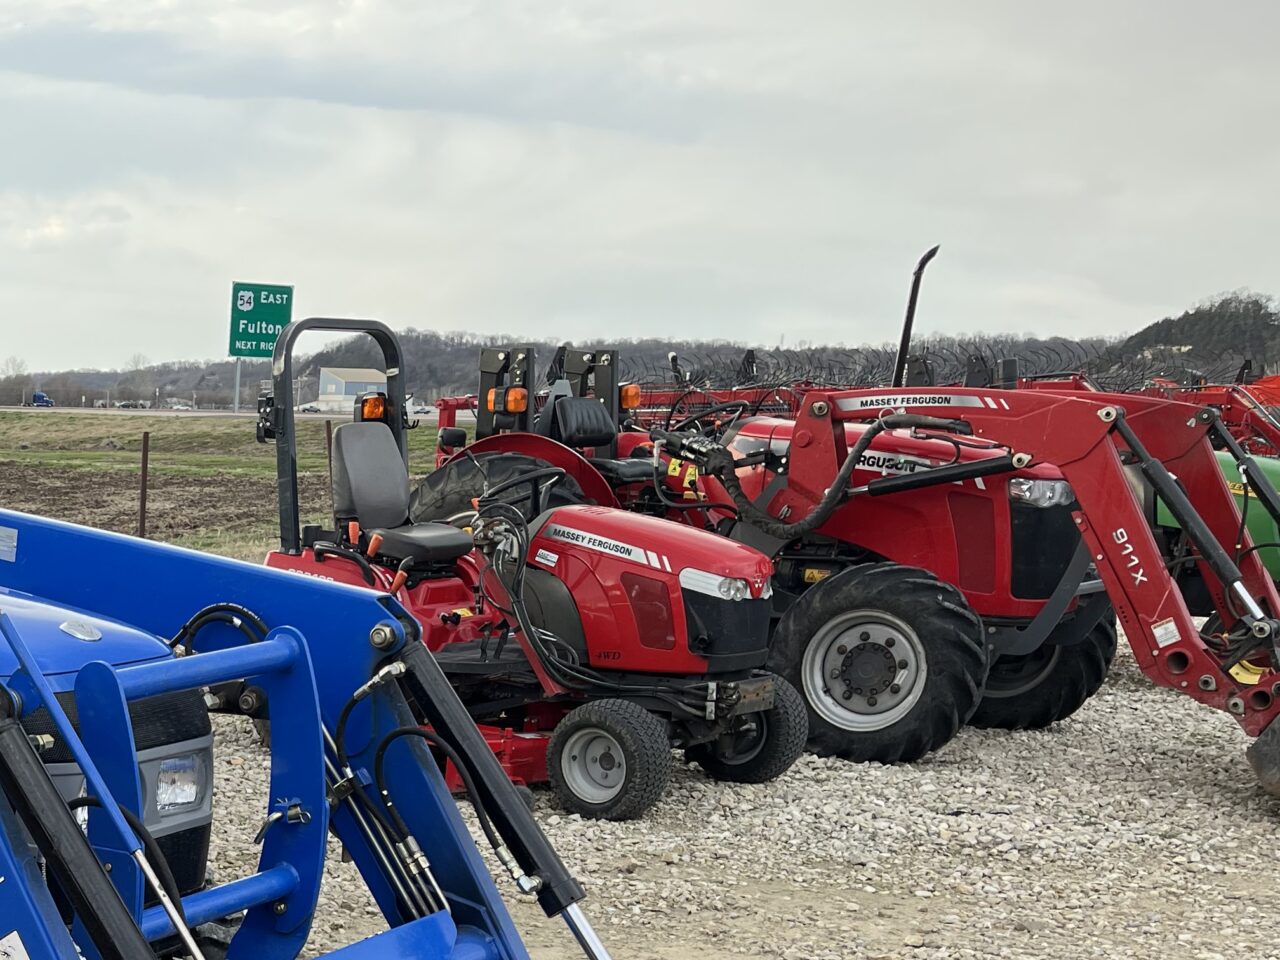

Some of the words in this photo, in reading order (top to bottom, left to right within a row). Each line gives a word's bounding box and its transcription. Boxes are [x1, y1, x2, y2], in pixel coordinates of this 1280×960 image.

[239, 295, 252, 306] 54
[261, 291, 288, 304] EAST
[239, 320, 282, 335] Fulton
[235, 340, 257, 350] NEXT
[260, 341, 275, 350] RIG
[860, 397, 898, 408] MASSEY
[901, 396, 951, 405] FERGUSON
[552, 528, 587, 543] MASSEY
[587, 537, 633, 557] FERGUSON
[1112, 528, 1148, 585] 911X
